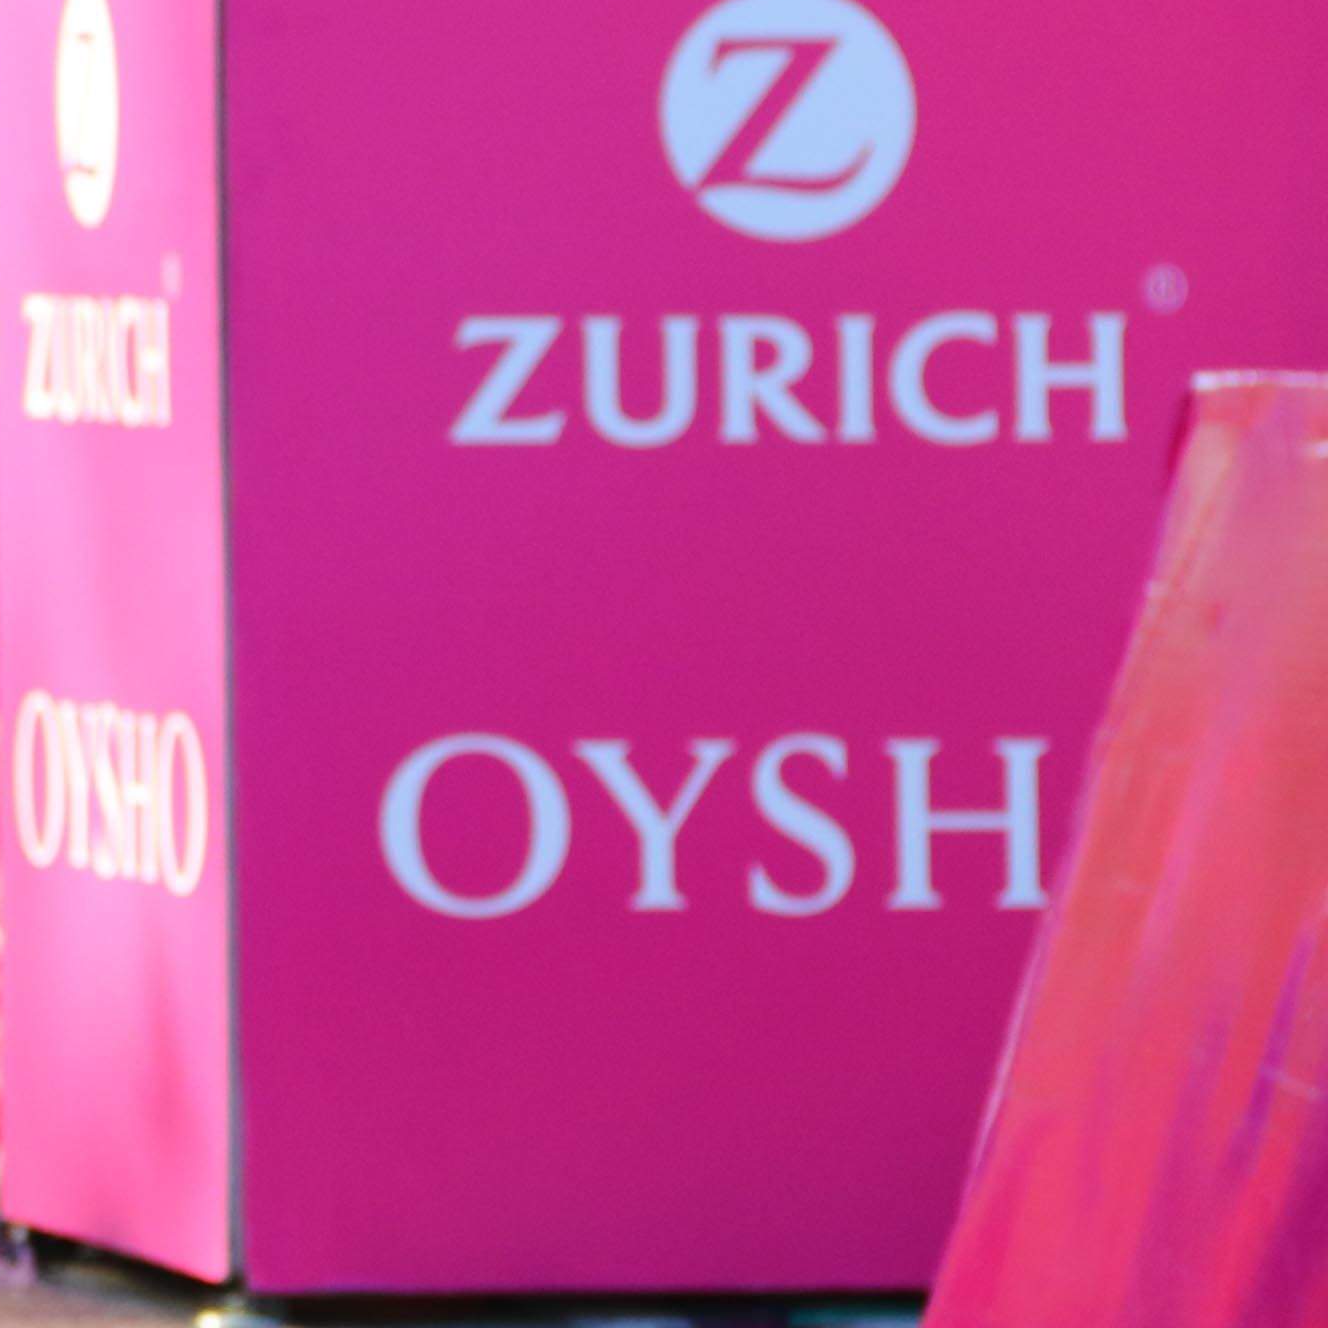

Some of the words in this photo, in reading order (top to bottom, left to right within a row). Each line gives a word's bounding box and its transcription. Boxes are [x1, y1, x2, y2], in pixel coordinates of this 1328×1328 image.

[21, 292, 173, 429] ZURICH
[448, 309, 1129, 449] ZURICH
[12, 689, 207, 898] OYSHO
